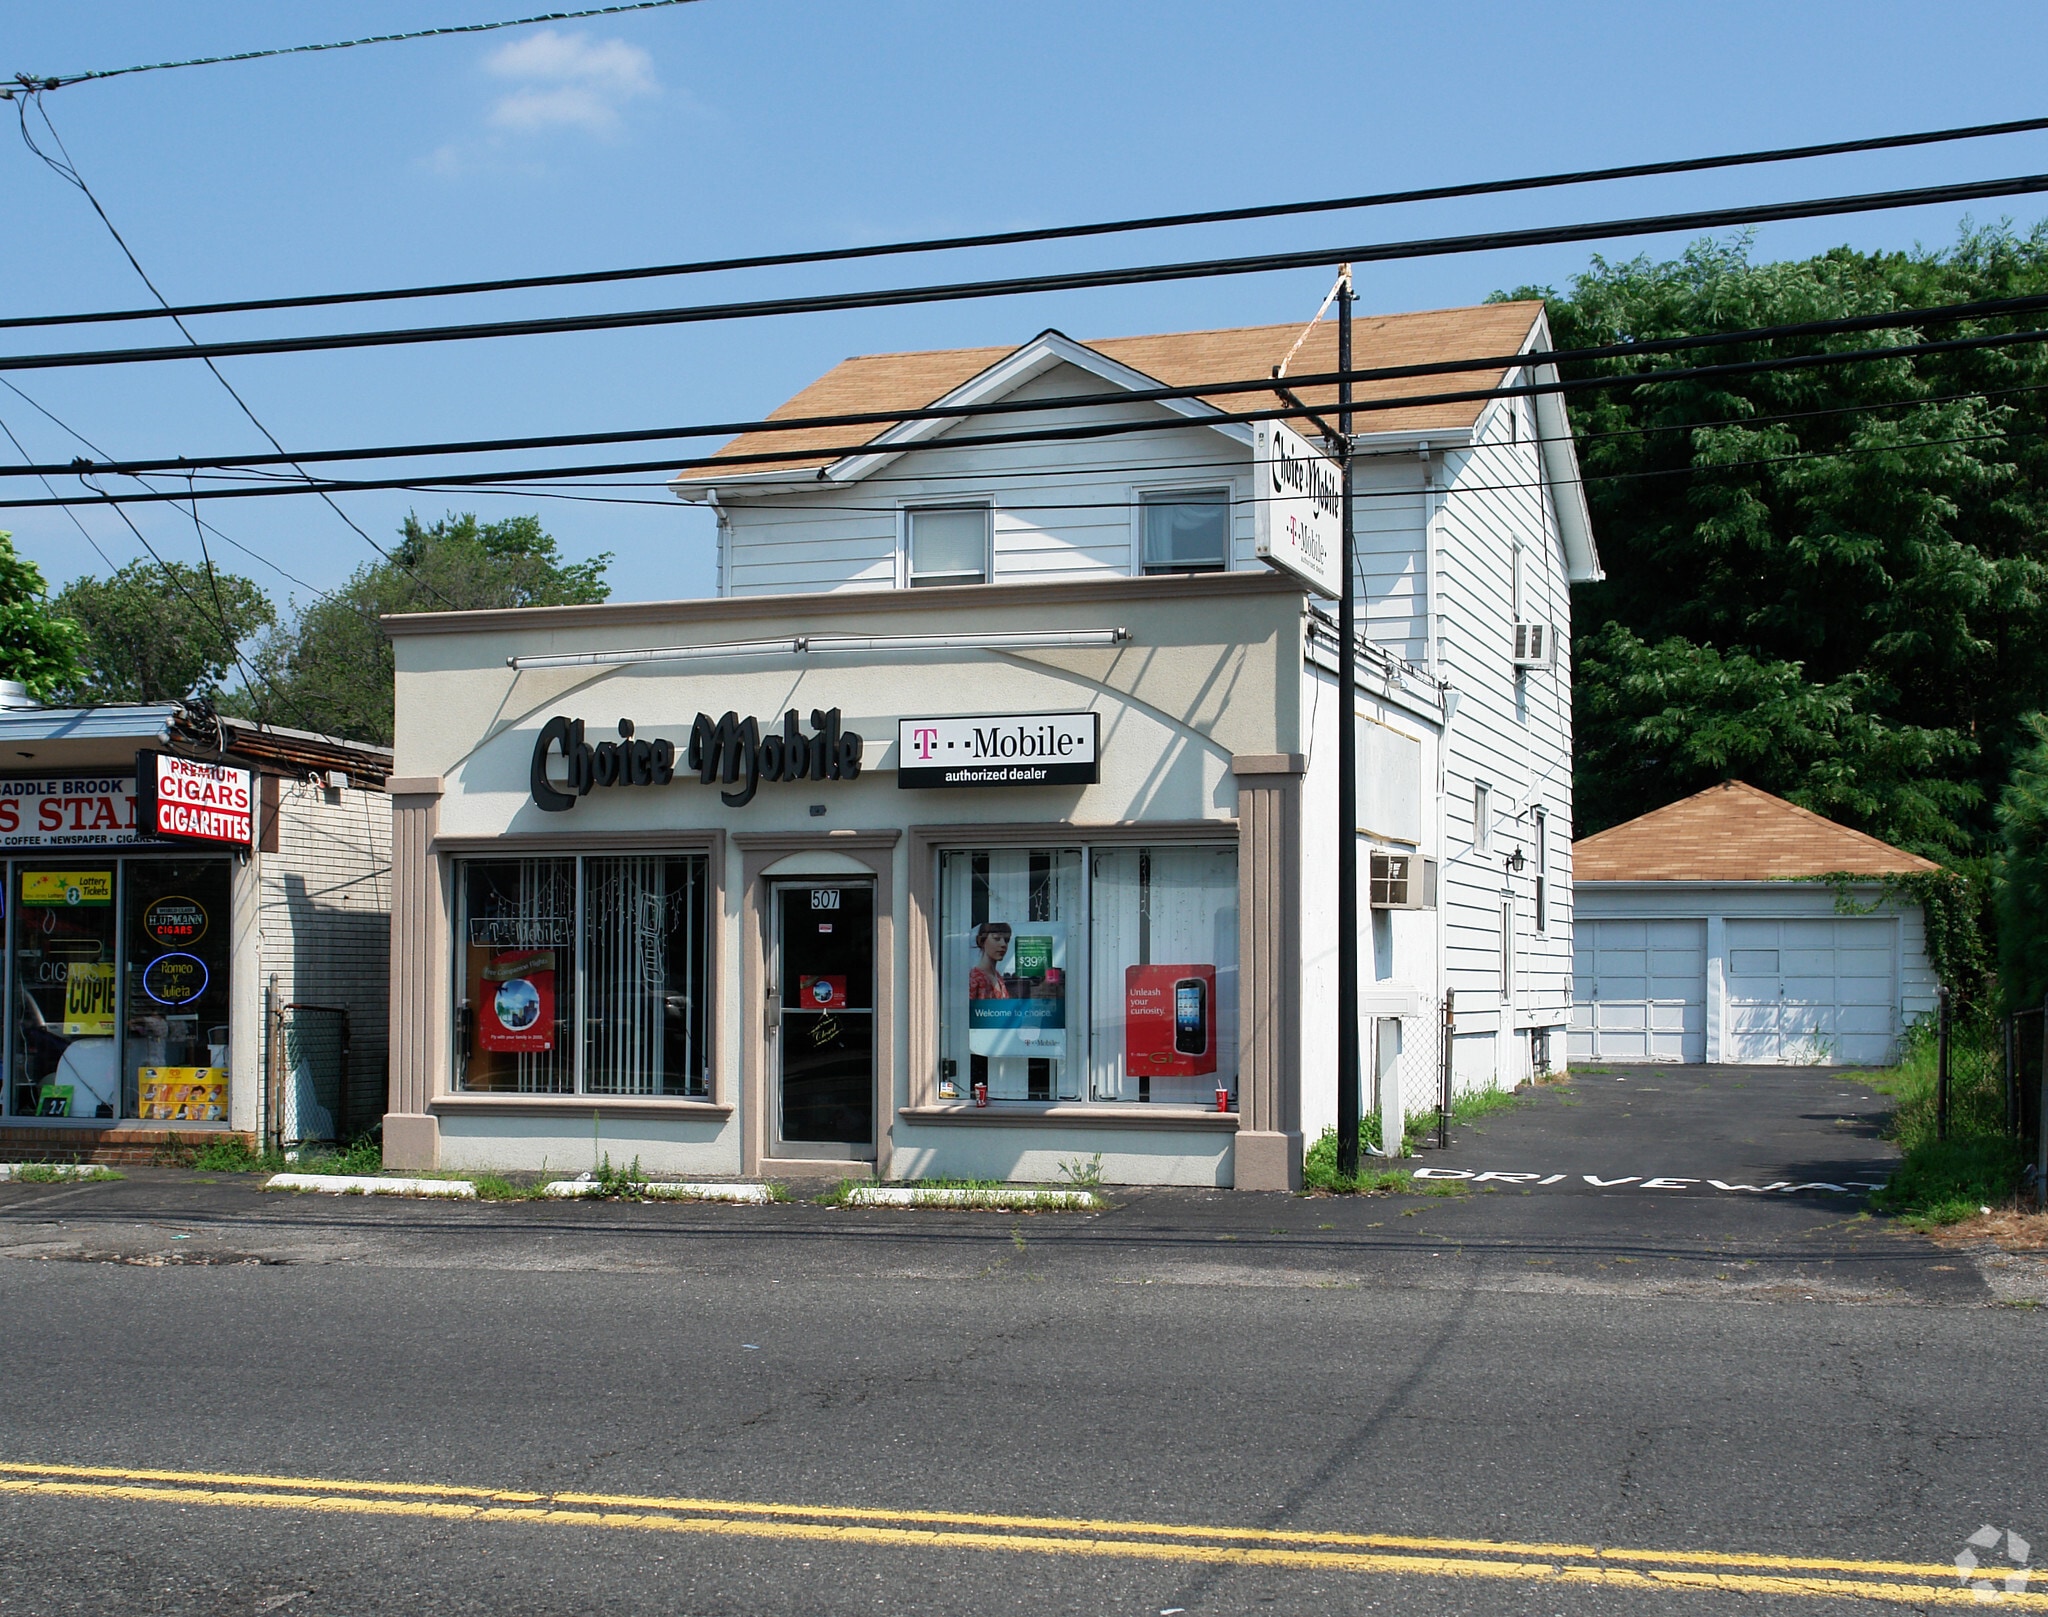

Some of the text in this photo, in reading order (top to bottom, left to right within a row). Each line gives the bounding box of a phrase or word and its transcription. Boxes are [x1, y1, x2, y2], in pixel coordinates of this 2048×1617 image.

[1272, 430, 1339, 520] Choice Mobile
[530, 707, 863, 811] Choice Mobile
[170, 761, 238, 784] PREMIUM
[945, 767, 1047, 783] authorized dealer
[0, 780, 124, 796] ADDLE BROOK
[160, 776, 248, 808] CIGARS
[160, 804, 250, 841] CIGARETTES
[5, 834, 166, 846] COFFEE NEWSPAPER CIGARE
[79, 877, 106, 887] Lottery
[83, 887, 109, 896] Tickets
[812, 890, 839, 909] 507
[157, 926, 193, 935] CIGARS
[40, 961, 99, 982] CIGARS
[161, 961, 193, 974] Romeo
[161, 985, 191, 998] Julieta
[1130, 988, 1161, 996] Unleash
[1130, 999, 1149, 1007] your
[974, 1008, 1012, 1017] Welcome
[1014, 1009, 1022, 1017] to
[1130, 1007, 1165, 1016] curiosity.
